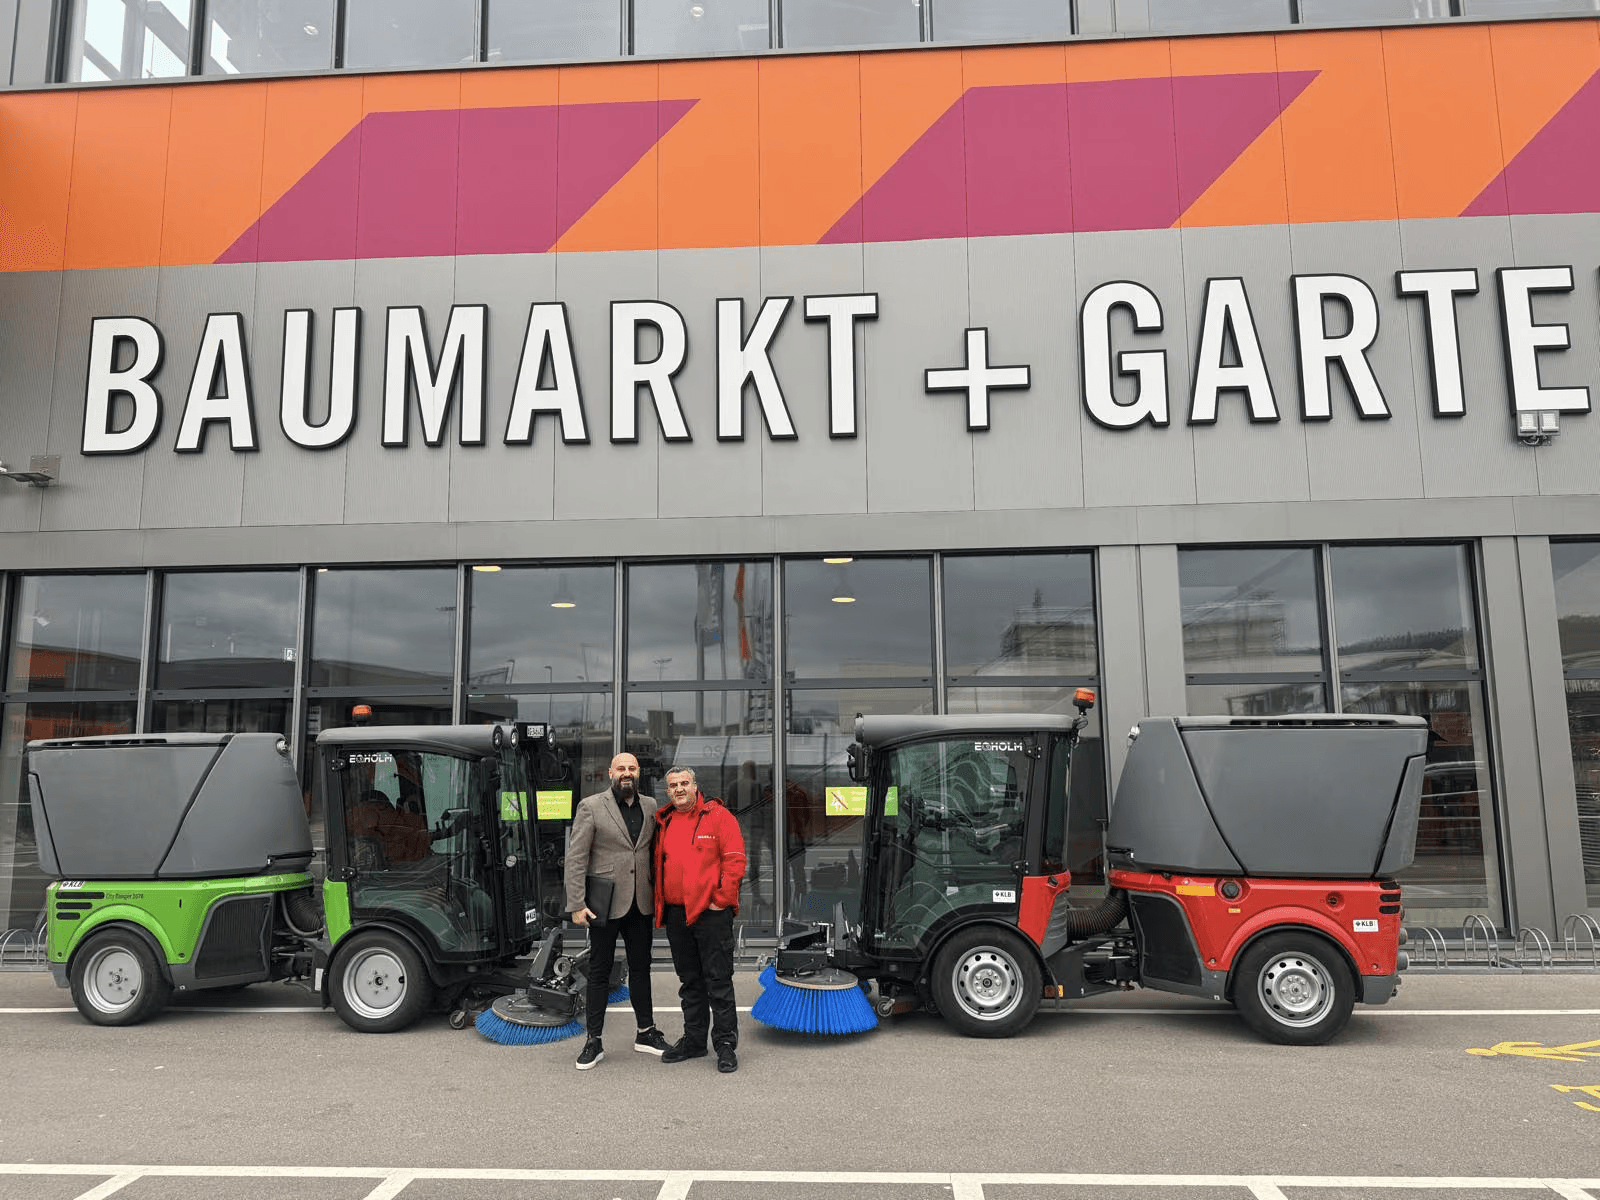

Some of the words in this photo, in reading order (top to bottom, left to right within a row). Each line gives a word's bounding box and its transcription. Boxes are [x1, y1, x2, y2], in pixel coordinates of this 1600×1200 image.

[81, 293, 878, 455] BAUMARKT
[924, 327, 1031, 432] +
[1081, 265, 1600, 430] GARTE
